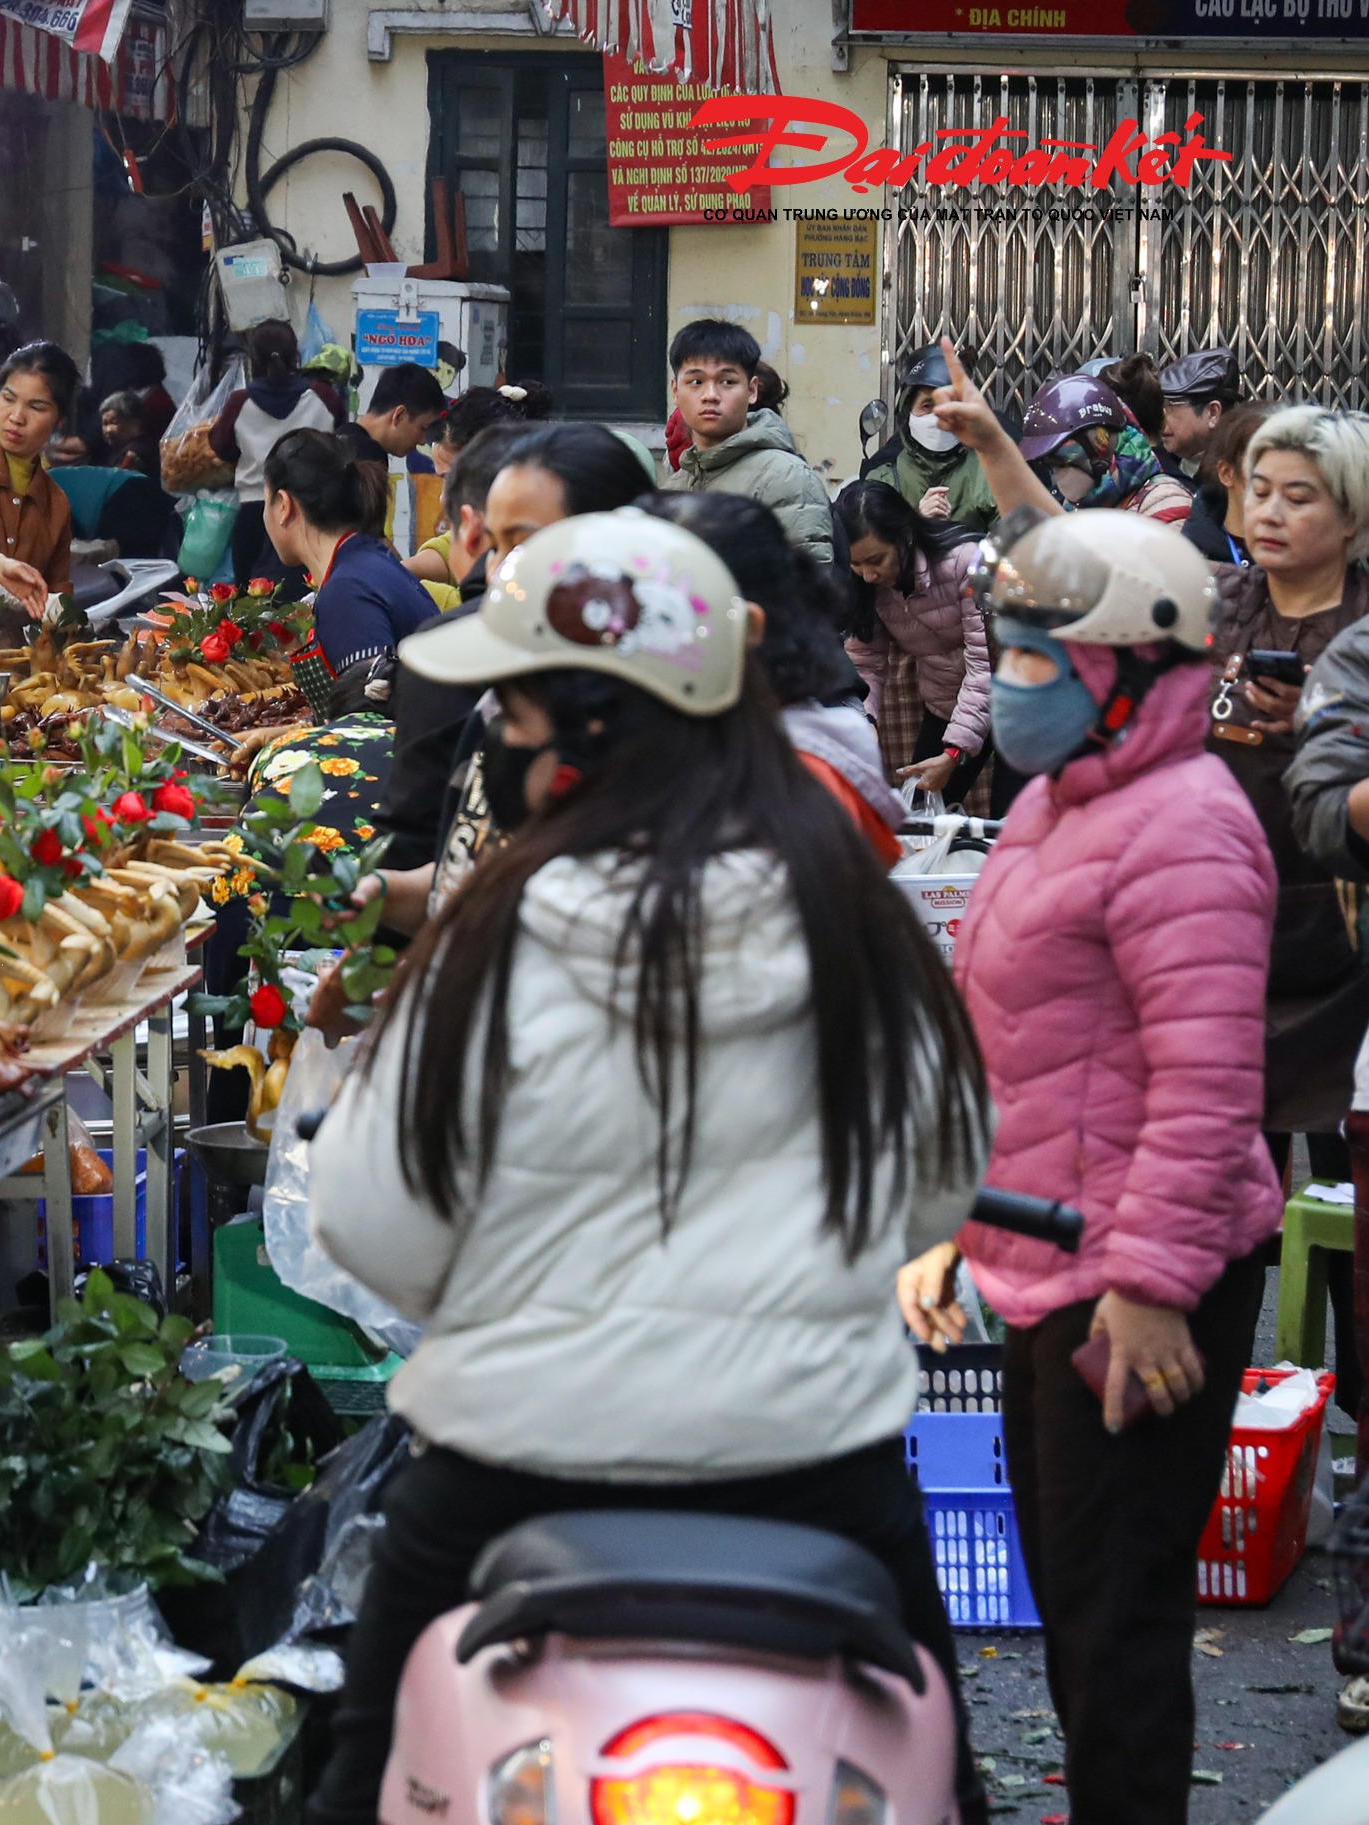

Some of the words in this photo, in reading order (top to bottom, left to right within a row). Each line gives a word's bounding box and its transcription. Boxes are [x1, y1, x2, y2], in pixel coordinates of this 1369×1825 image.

[969, 8, 1002, 30] ĐỊA
[1007, 6, 1066, 28] CHÍNH
[610, 83, 629, 103] CÁC
[631, 86, 649, 105] QUY
[651, 85, 674, 106] ĐỊNH
[620, 106, 633, 130] SỬ
[634, 112, 660, 134] DỤNG
[661, 109, 674, 129] VŨ
[609, 138, 635, 158] CÔNG
[637, 142, 649, 161] CỤ
[666, 139, 684, 160] TRỢ
[611, 165, 624, 185] VÀ
[626, 167, 649, 188] NGHỊ
[651, 167, 673, 188] ĐỊNH
[675, 161, 687, 184] SỐ
[641, 187, 667, 213] QUẢN
[668, 191, 682, 213] LÝ,
[684, 187, 698, 210] SỬ
[802, 252, 841, 268] TRUNG
